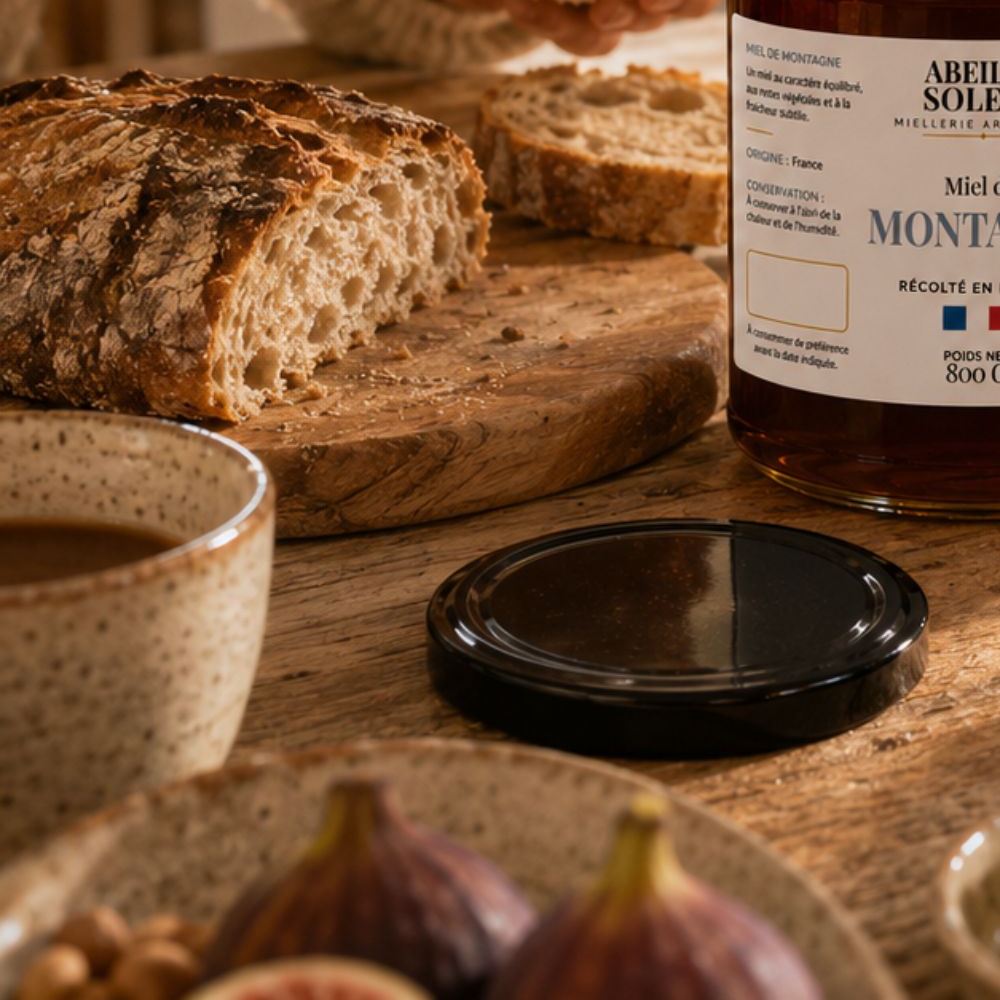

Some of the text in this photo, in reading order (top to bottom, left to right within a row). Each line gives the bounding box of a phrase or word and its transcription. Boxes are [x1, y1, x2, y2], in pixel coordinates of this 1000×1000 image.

[746, 43, 842, 68] MIEL DE MONTAGNE
[894, 118, 974, 129] MIELLERIE
[746, 146, 784, 166] ORIGINE
[792, 156, 824, 171] France
[746, 179, 819, 202] CONSERVATION
[944, 175, 988, 196] Miel
[899, 278, 966, 294] RÉCOLTÉ
[972, 282, 992, 294] EN
[943, 350, 982, 362] POIDS
[946, 363, 986, 384] 800
